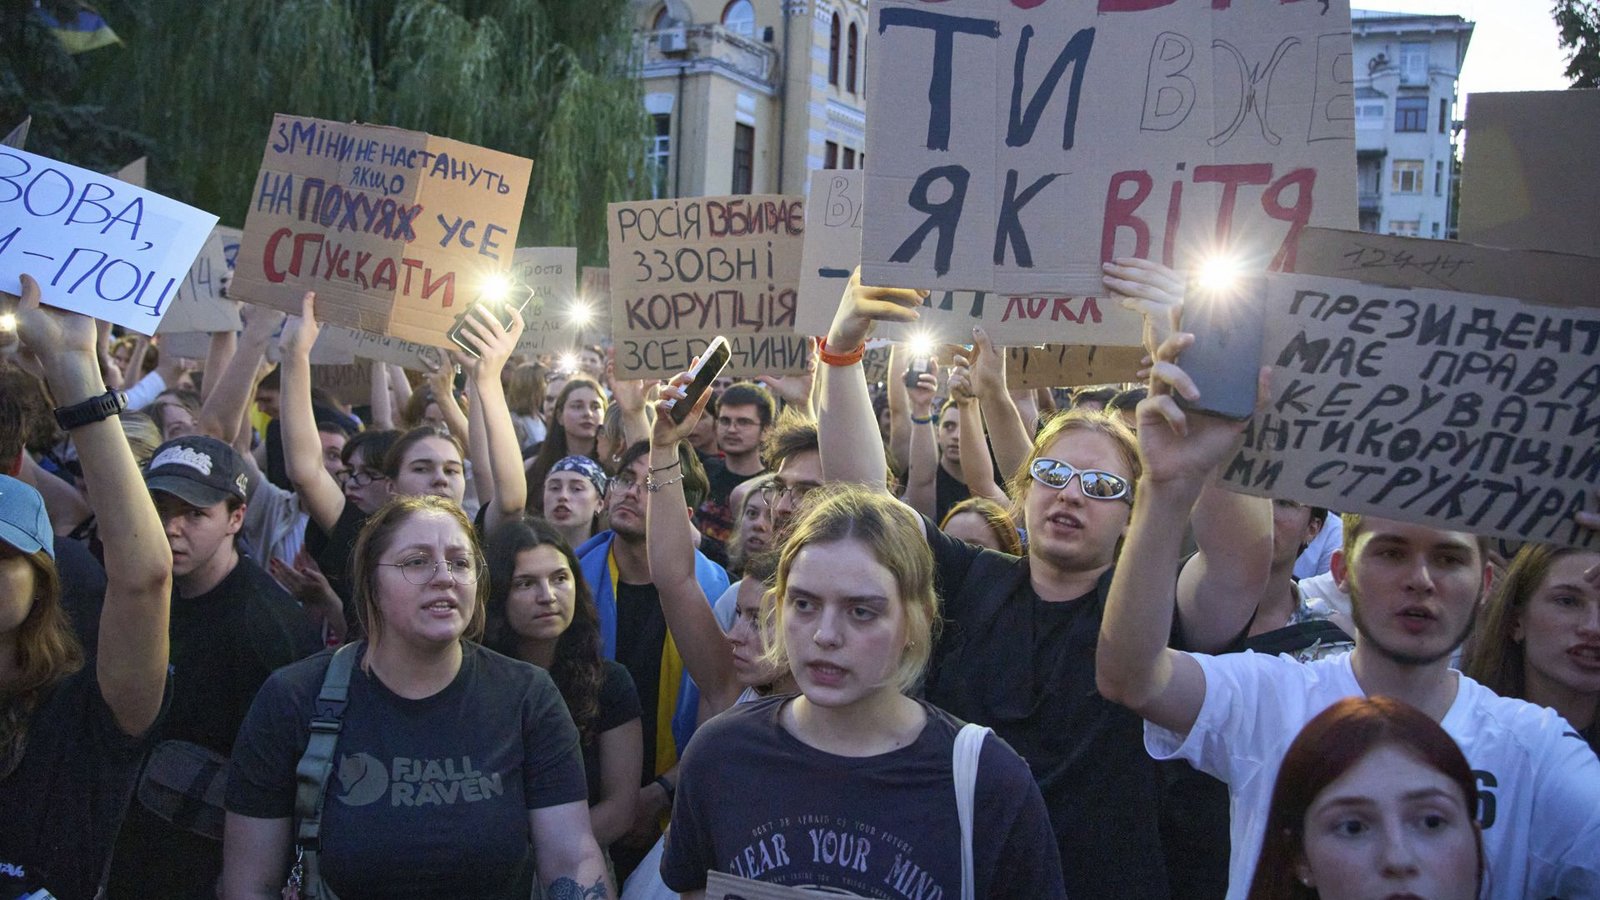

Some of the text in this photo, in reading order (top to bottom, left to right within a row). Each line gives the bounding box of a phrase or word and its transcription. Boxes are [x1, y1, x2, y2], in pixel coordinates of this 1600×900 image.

[879, 7, 1096, 152] ТИ
[273, 120, 510, 194] ЗМІНИ НЕ НАСТАНУТЬ
[349, 167, 405, 195] ЯКЩО
[257, 171, 507, 261] НА ПОХУЯХ УСЕ
[618, 200, 804, 243] РОСІЯ ВБИВАЄ
[887, 162, 1316, 278] ЯК ВІТЯ
[263, 227, 456, 308] СПУСКАТИ
[633, 241, 773, 282] ЗЗОВНІ
[625, 284, 797, 332] КОРУПЦІЯ
[1289, 289, 1600, 355] ПРЕЗИДЕНТ
[624, 336, 807, 370] ЗСЕРДИНИ
[1276, 330, 1600, 402] МАЄ ПРАВА
[1274, 380, 1600, 438] КЕРУВАТИ
[1222, 451, 1284, 490] МИ
[808, 828, 871, 873] YOUR
